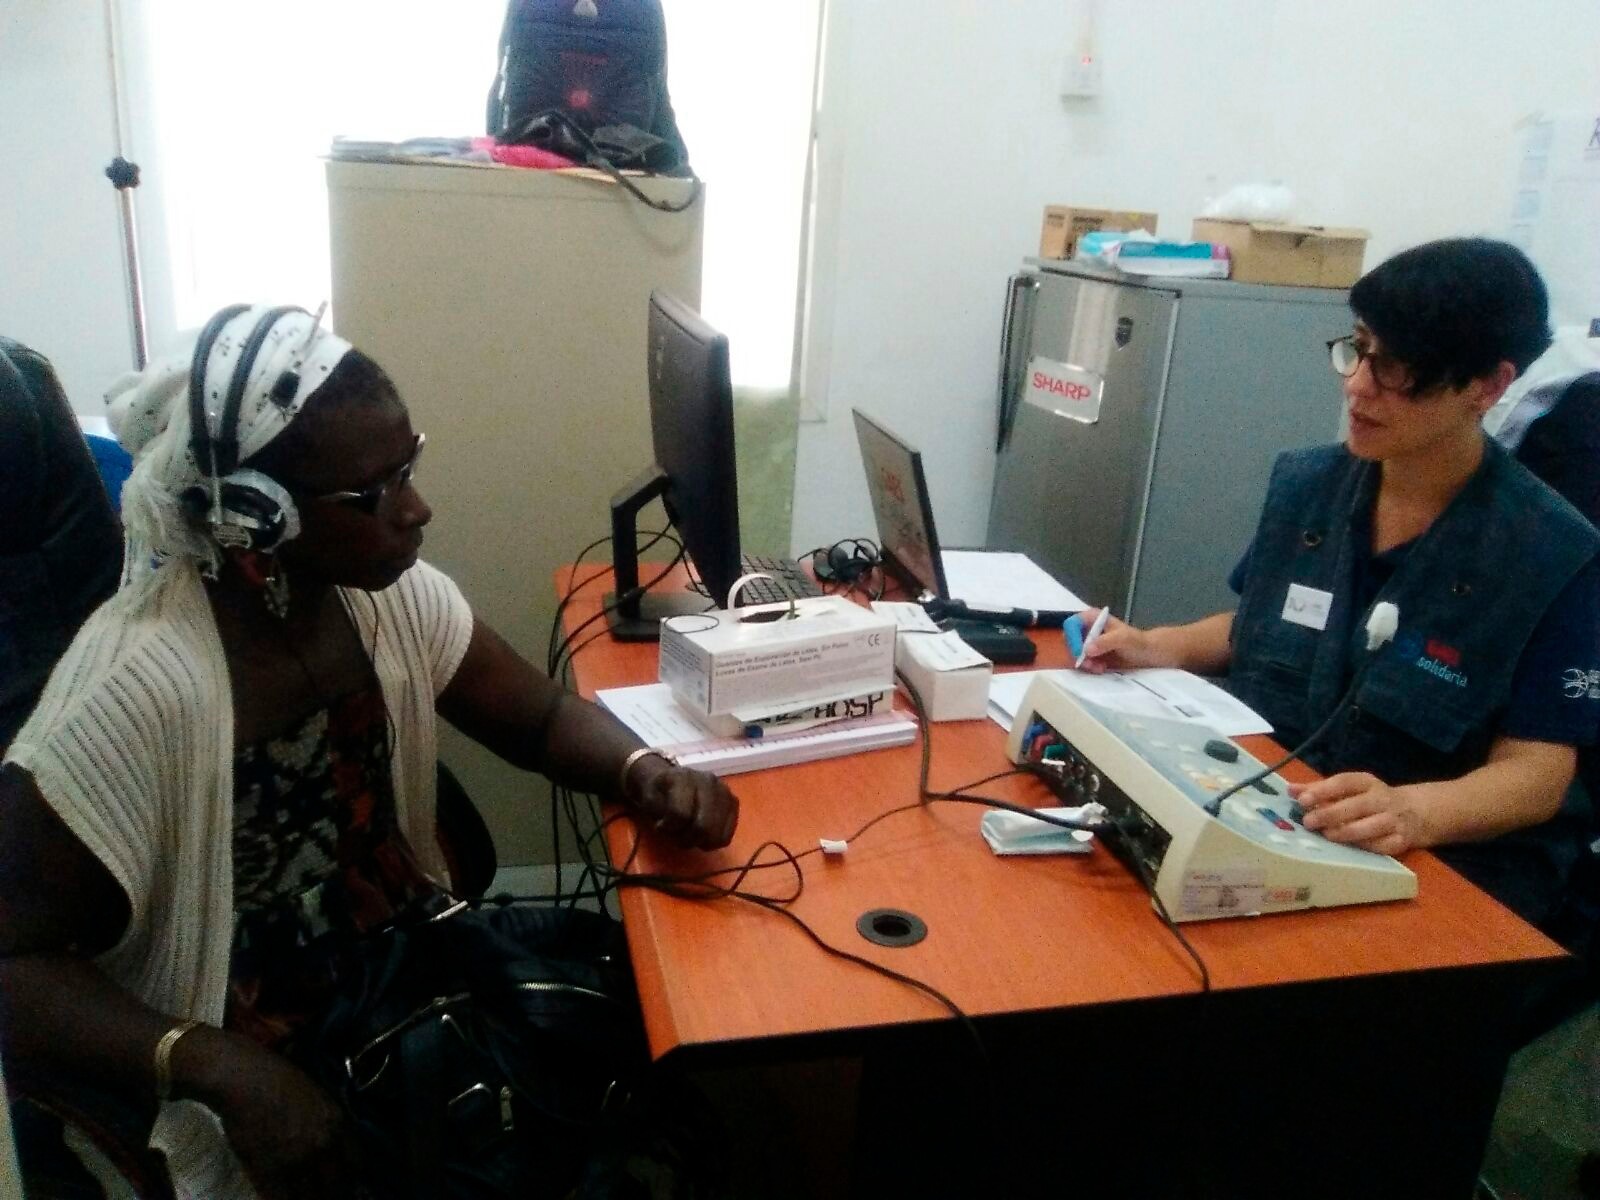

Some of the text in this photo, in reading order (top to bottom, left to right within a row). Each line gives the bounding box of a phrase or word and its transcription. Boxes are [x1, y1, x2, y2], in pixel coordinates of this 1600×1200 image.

[1033, 372, 1092, 400] SHARP
[868, 633, 881, 647] CE
[1416, 656, 1468, 688] solidaria
